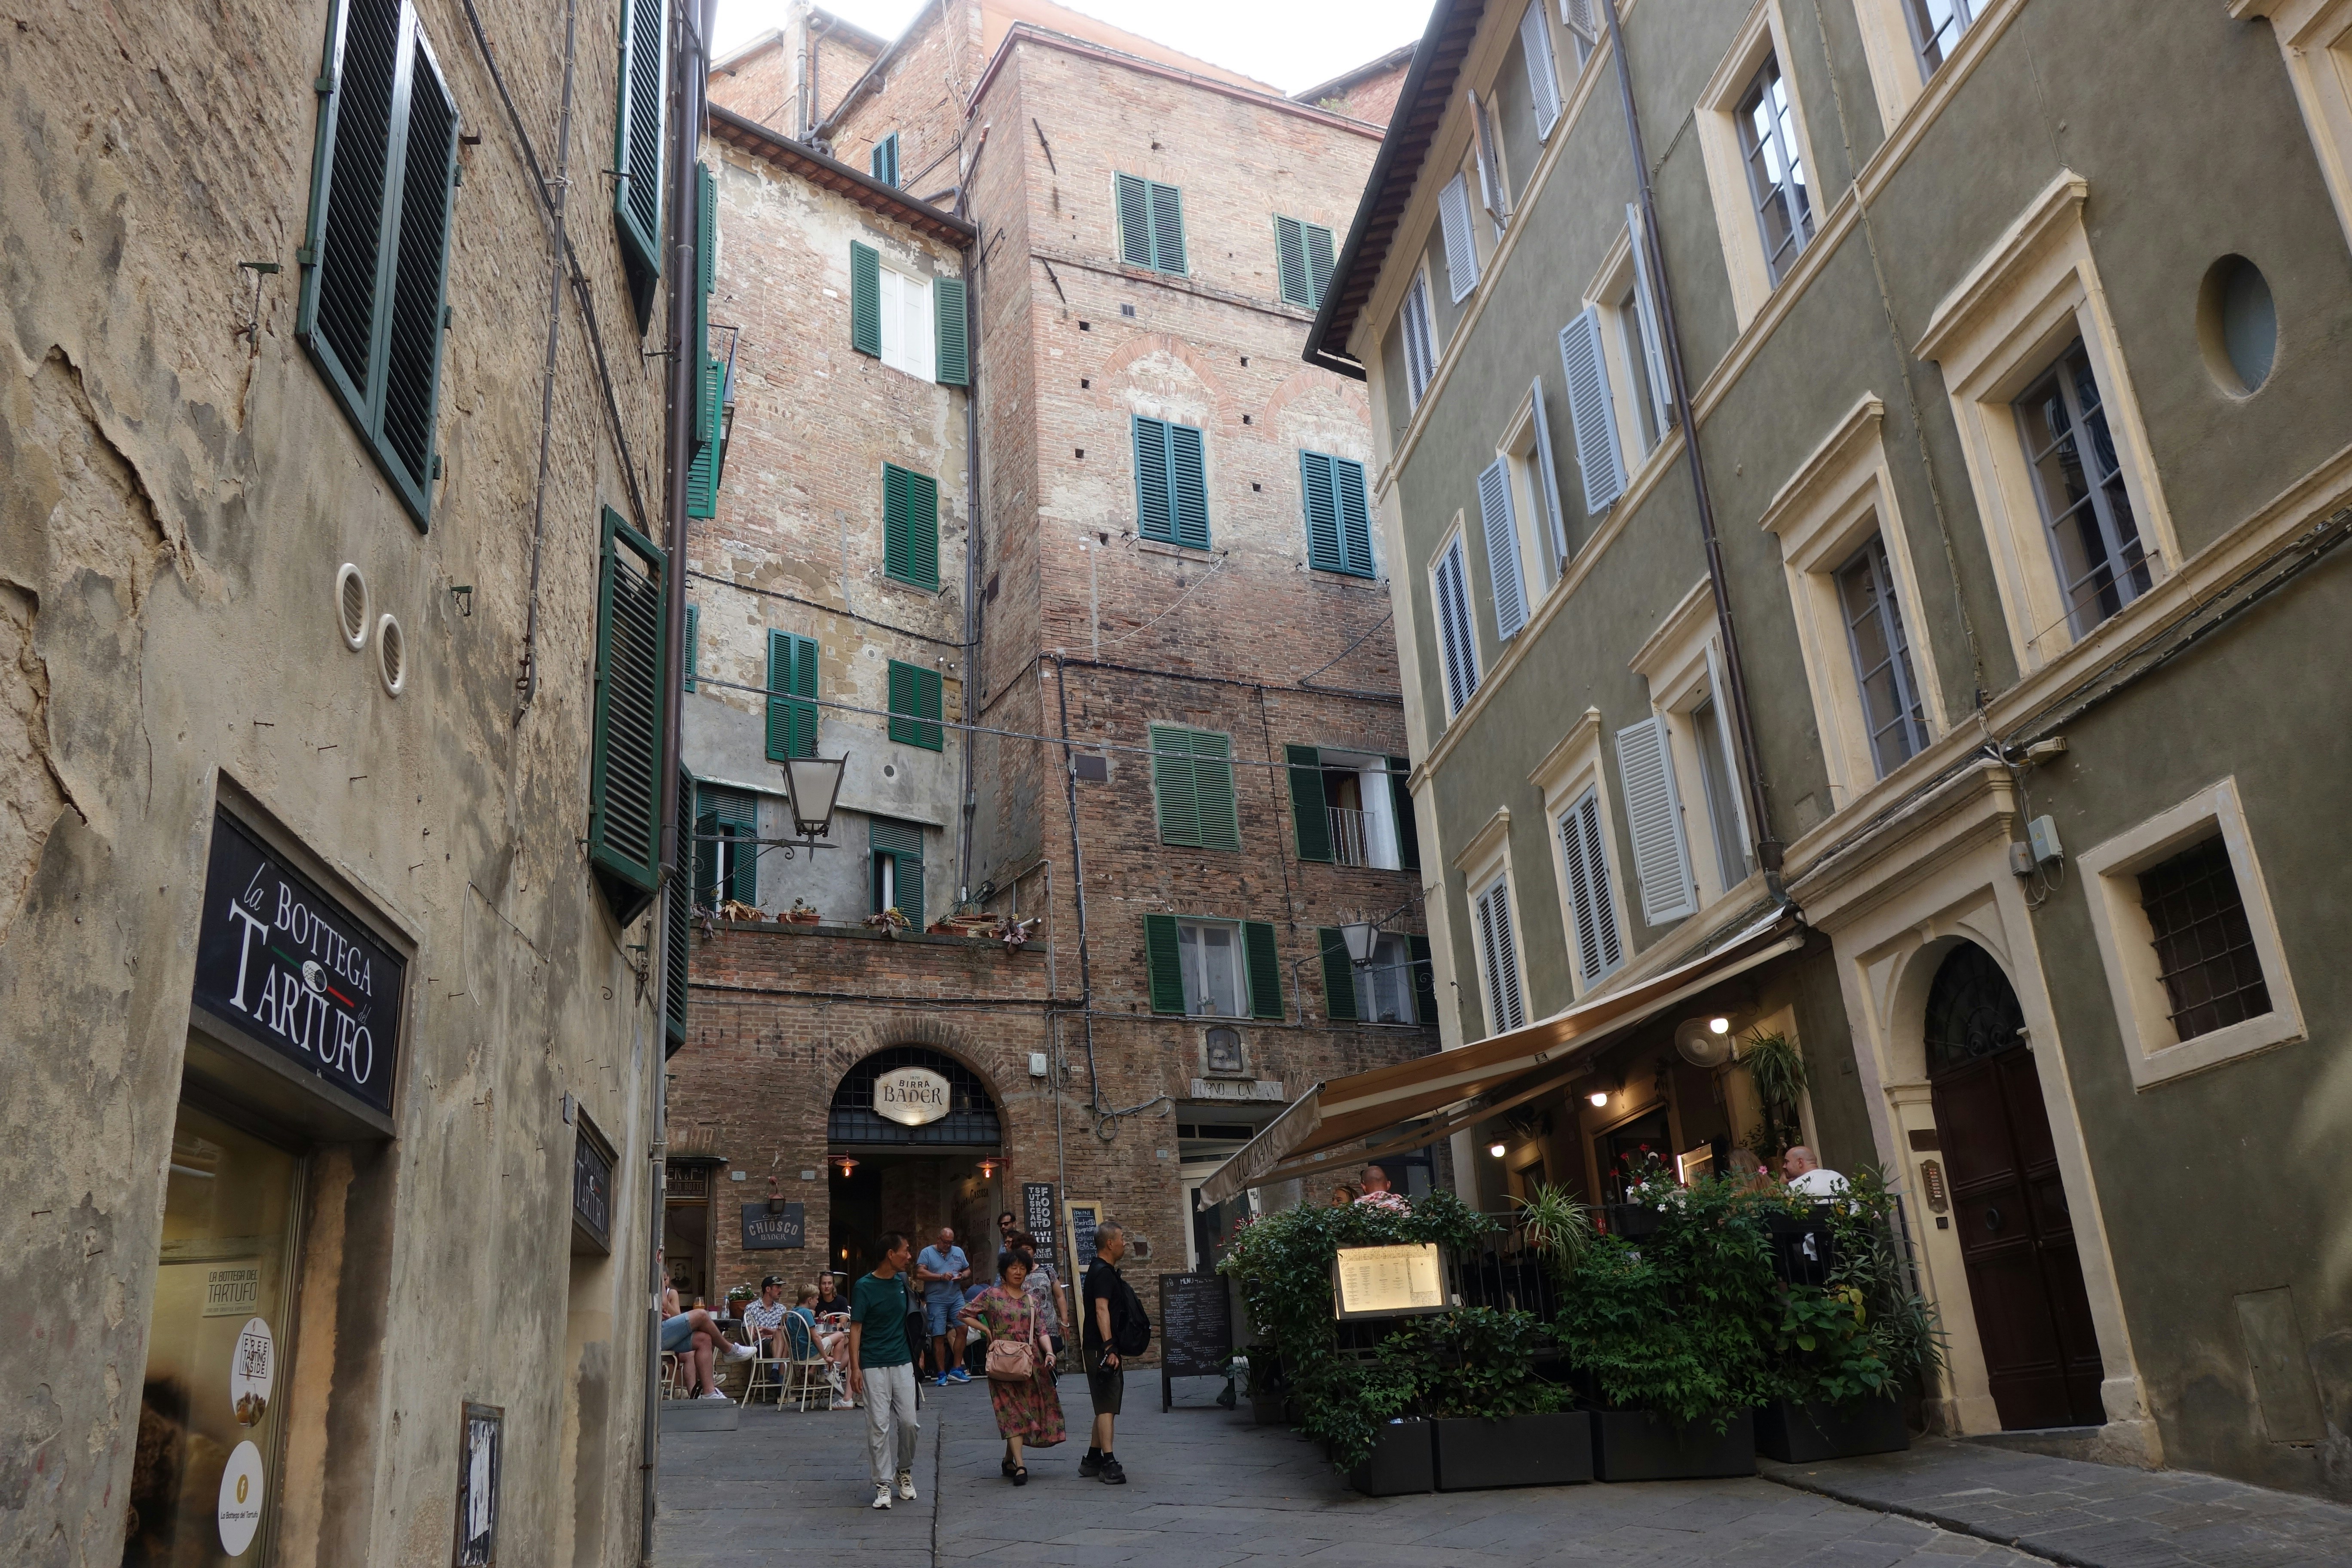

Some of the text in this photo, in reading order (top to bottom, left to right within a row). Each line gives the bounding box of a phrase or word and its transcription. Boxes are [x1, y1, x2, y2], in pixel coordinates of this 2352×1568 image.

[244, 862, 373, 997] la BOTTEGA
[229, 898, 373, 1084] TARTUFO
[358, 1004, 372, 1026] del
[899, 1080, 930, 1088] BIRRA
[1193, 1082, 1225, 1096] FORNO
[884, 1085, 942, 1106] BADER
[585, 1142, 604, 1185] BOTTEGA
[576, 1156, 604, 1232] TARTUFO
[685, 1182, 703, 1191] BOTTE
[970, 1188, 989, 1204] GASSOSA
[1028, 1187, 1036, 1228] TUSCAN
[1041, 1187, 1050, 1227] FOOD
[748, 1221, 798, 1236] CHIOSCO
[209, 1269, 258, 1282] LA BOTTEGA DEL
[208, 1282, 257, 1303] TARTUFO
[244, 1338, 267, 1353] FREE
[244, 1349, 266, 1363] TASTING
[242, 1360, 265, 1375] INSIDE
[226, 1511, 239, 1522] Bottega
